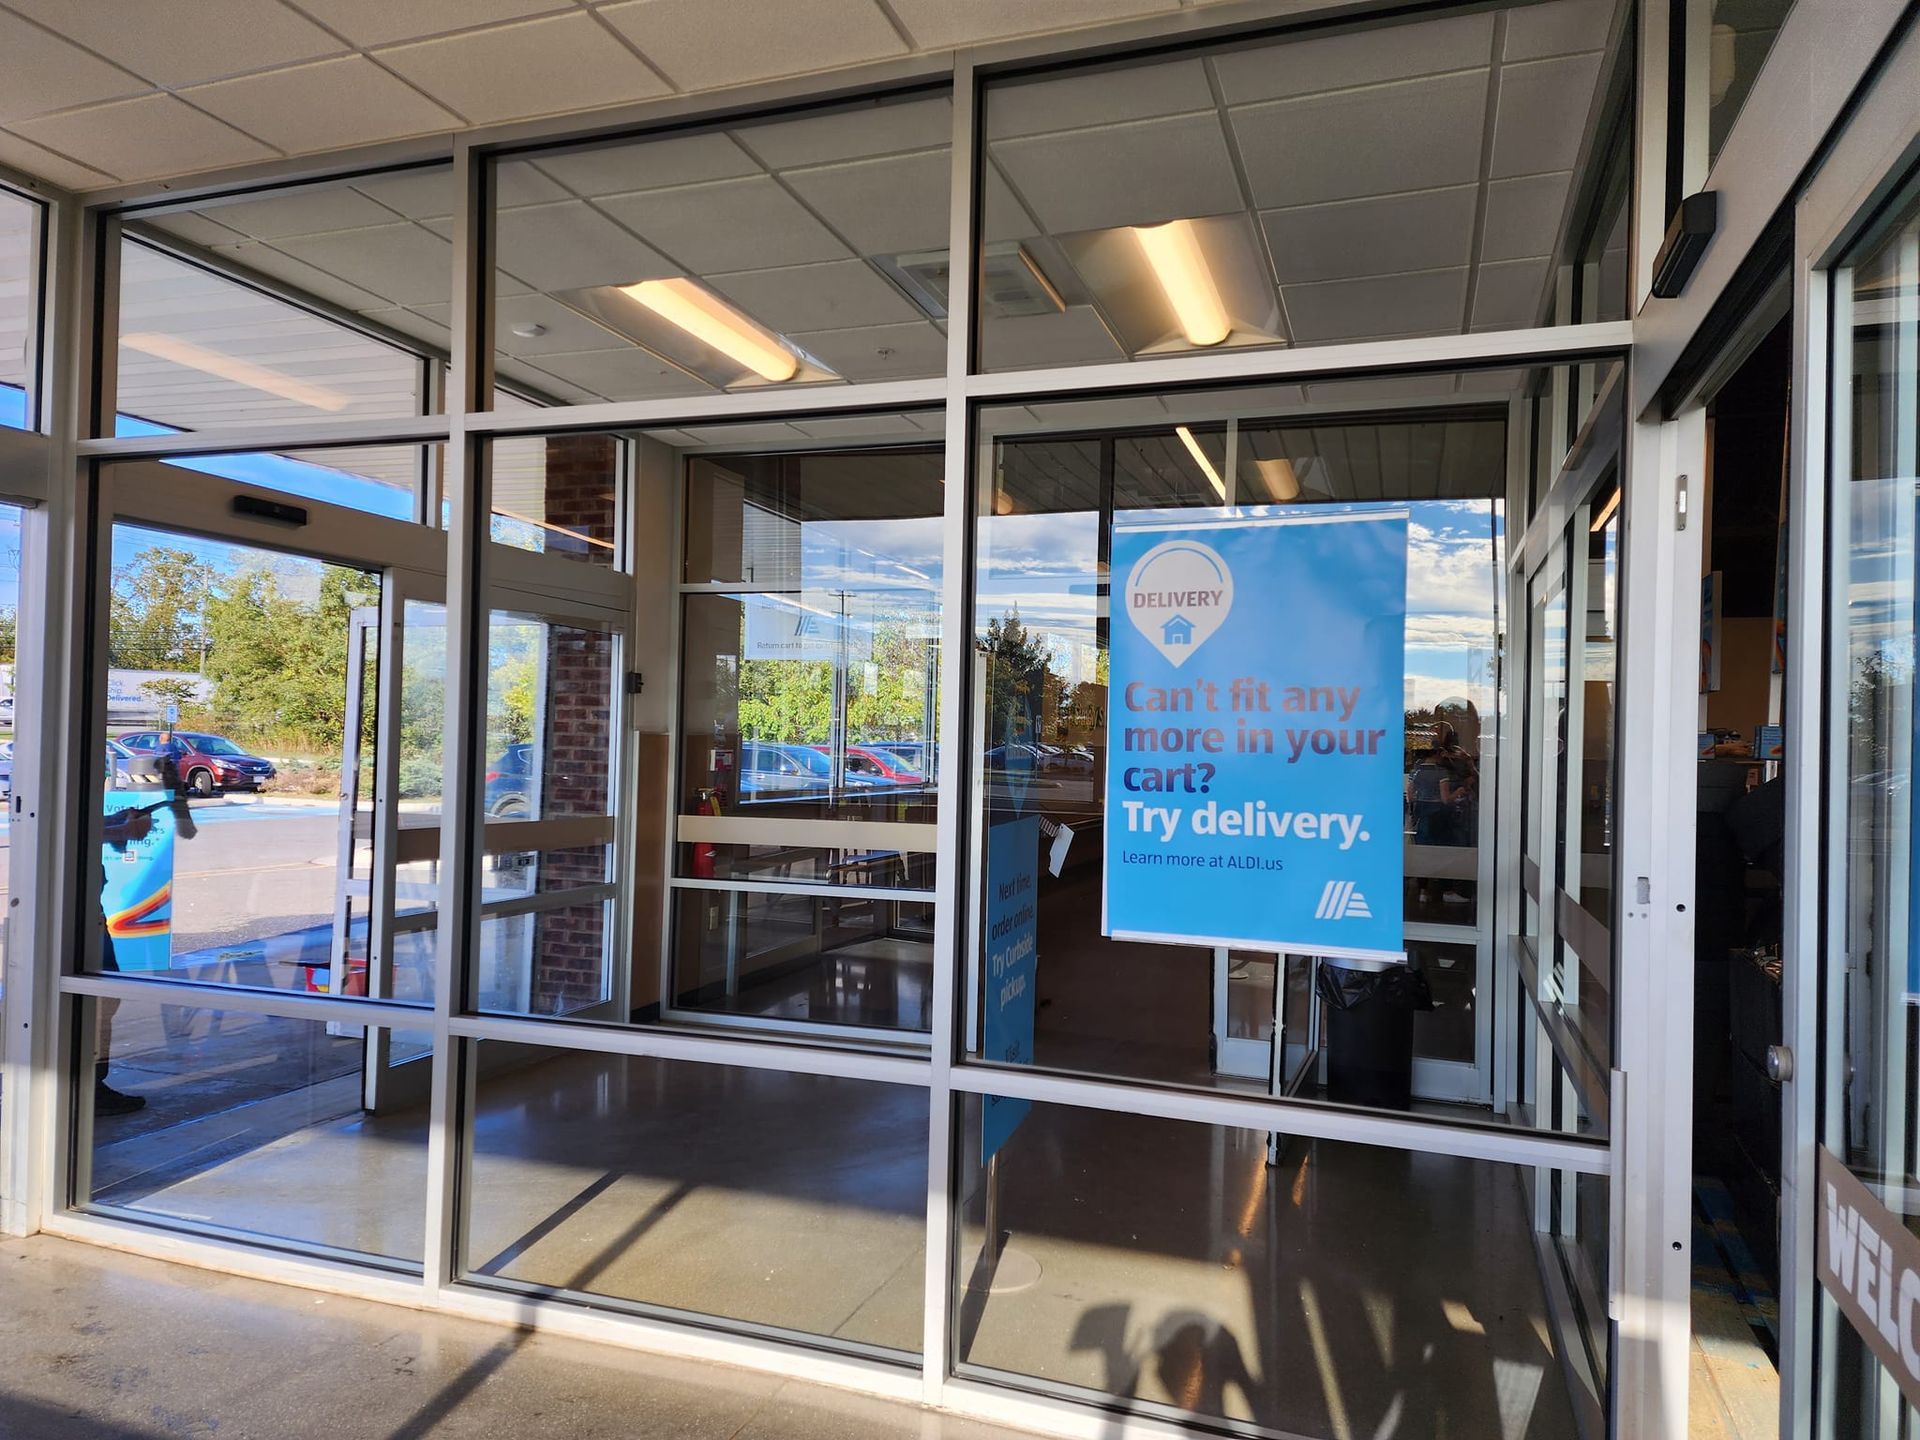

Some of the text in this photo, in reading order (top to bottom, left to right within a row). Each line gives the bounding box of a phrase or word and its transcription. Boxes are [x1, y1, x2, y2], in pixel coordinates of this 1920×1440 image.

[1133, 590, 1223, 609] DELIVERY
[1124, 677, 1362, 723] Can't fit any
[1123, 718, 1387, 764] more in your
[1123, 762, 1217, 794] cart?
[1121, 801, 1371, 850] Try delivery.
[1122, 850, 1284, 871] Learn more at ALDI.us
[998, 878, 1016, 902] Next
[991, 914, 1013, 941] order
[992, 932, 1033, 979] Try Curbside
